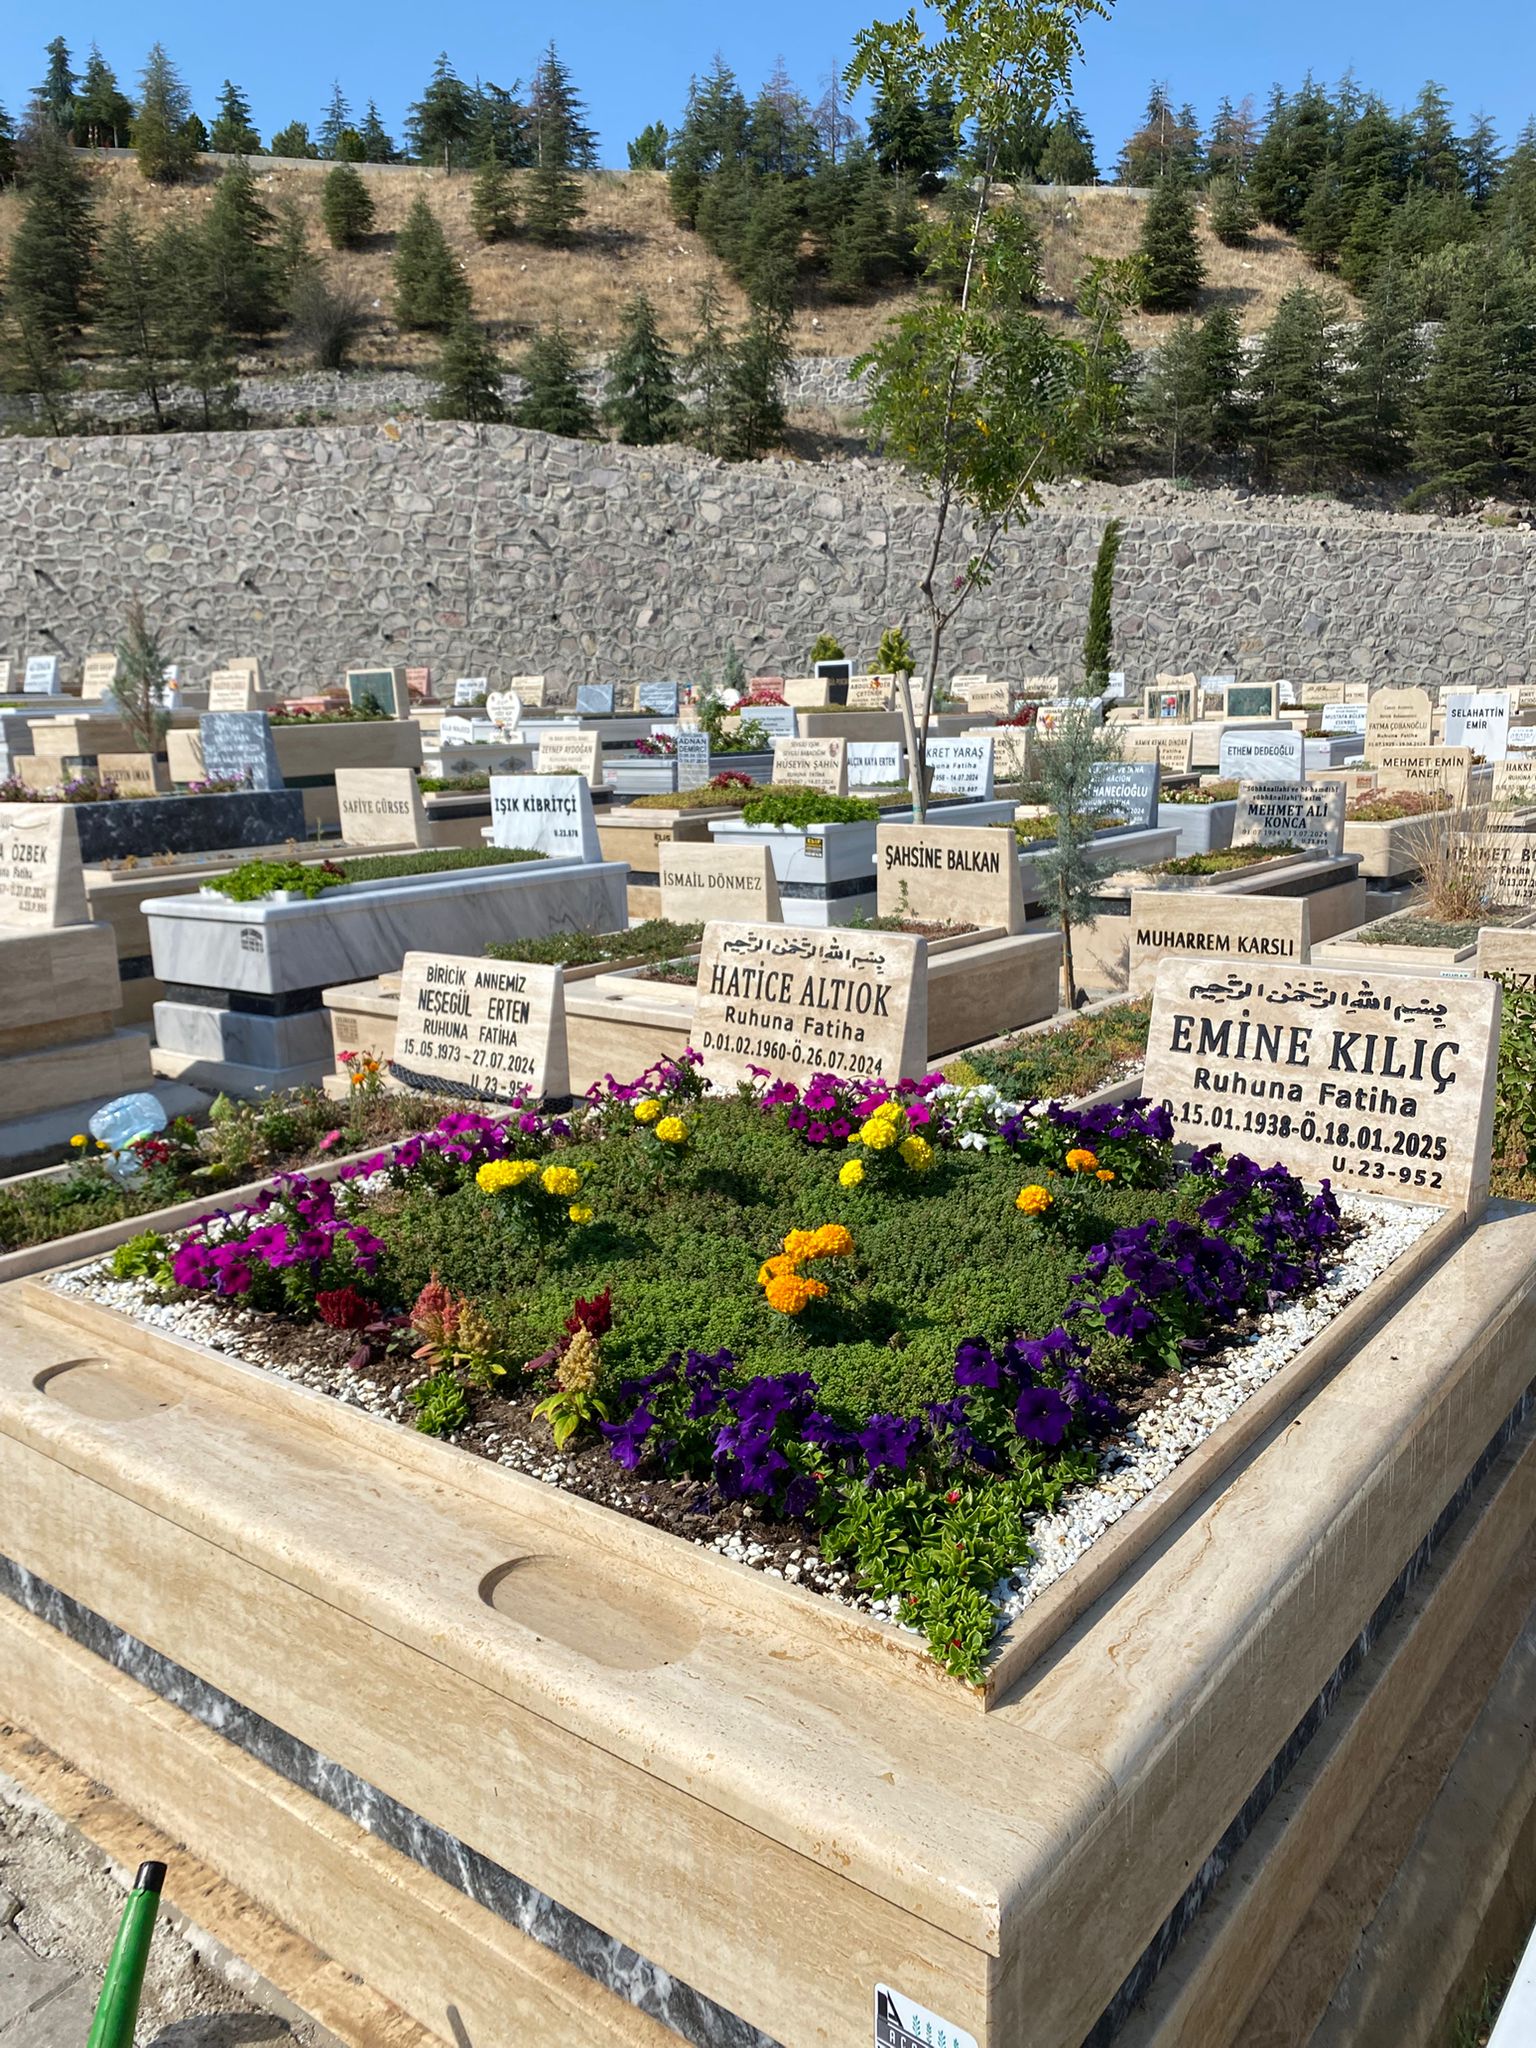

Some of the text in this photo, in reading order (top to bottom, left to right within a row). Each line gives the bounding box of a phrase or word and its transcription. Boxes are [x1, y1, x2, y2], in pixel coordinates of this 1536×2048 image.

[1451, 706, 1504, 718] SELAHATTİN
[1466, 719, 1487, 729] EMİR
[925, 747, 951, 758] KRET
[953, 746, 984, 760] YARAŞ
[1227, 744, 1295, 756] ETHEM DEDEOĞLU
[776, 759, 839, 771] HÜSEYİN ŞAHİN
[1383, 755, 1464, 767] MEHMET EMİN
[1506, 762, 1532, 772] HAKKI
[1406, 769, 1441, 778] TANER
[342, 797, 410, 815] SAFİYE GÜRSES
[495, 794, 577, 816] IŞIK KİBRİTÇİ
[1248, 802, 1329, 817] MEHMET ALİ
[1264, 817, 1307, 829] KONCA
[12, 837, 48, 863] ÖZBEK
[885, 840, 1000, 873] ŞAHSİNE BALKAN
[663, 870, 762, 891] İSMAİL DÖNMEZ
[1136, 928, 1294, 957] MUHARREM KARSLI
[426, 963, 527, 994] BİRİCİK ANNEMİZ
[709, 960, 893, 1018] HATİCE ALTIOK
[418, 988, 530, 1025] NEŞEGÜL ERTEN
[423, 1018, 518, 1048] RUHUNA FATİHA
[724, 1005, 866, 1043] Ruhuna Fatiha
[1169, 1009, 1460, 1095] EMİNE KILIÇ
[1193, 1067, 1418, 1118] Ruhuna Fatiha
[1331, 1155, 1444, 1190] U.23-952
